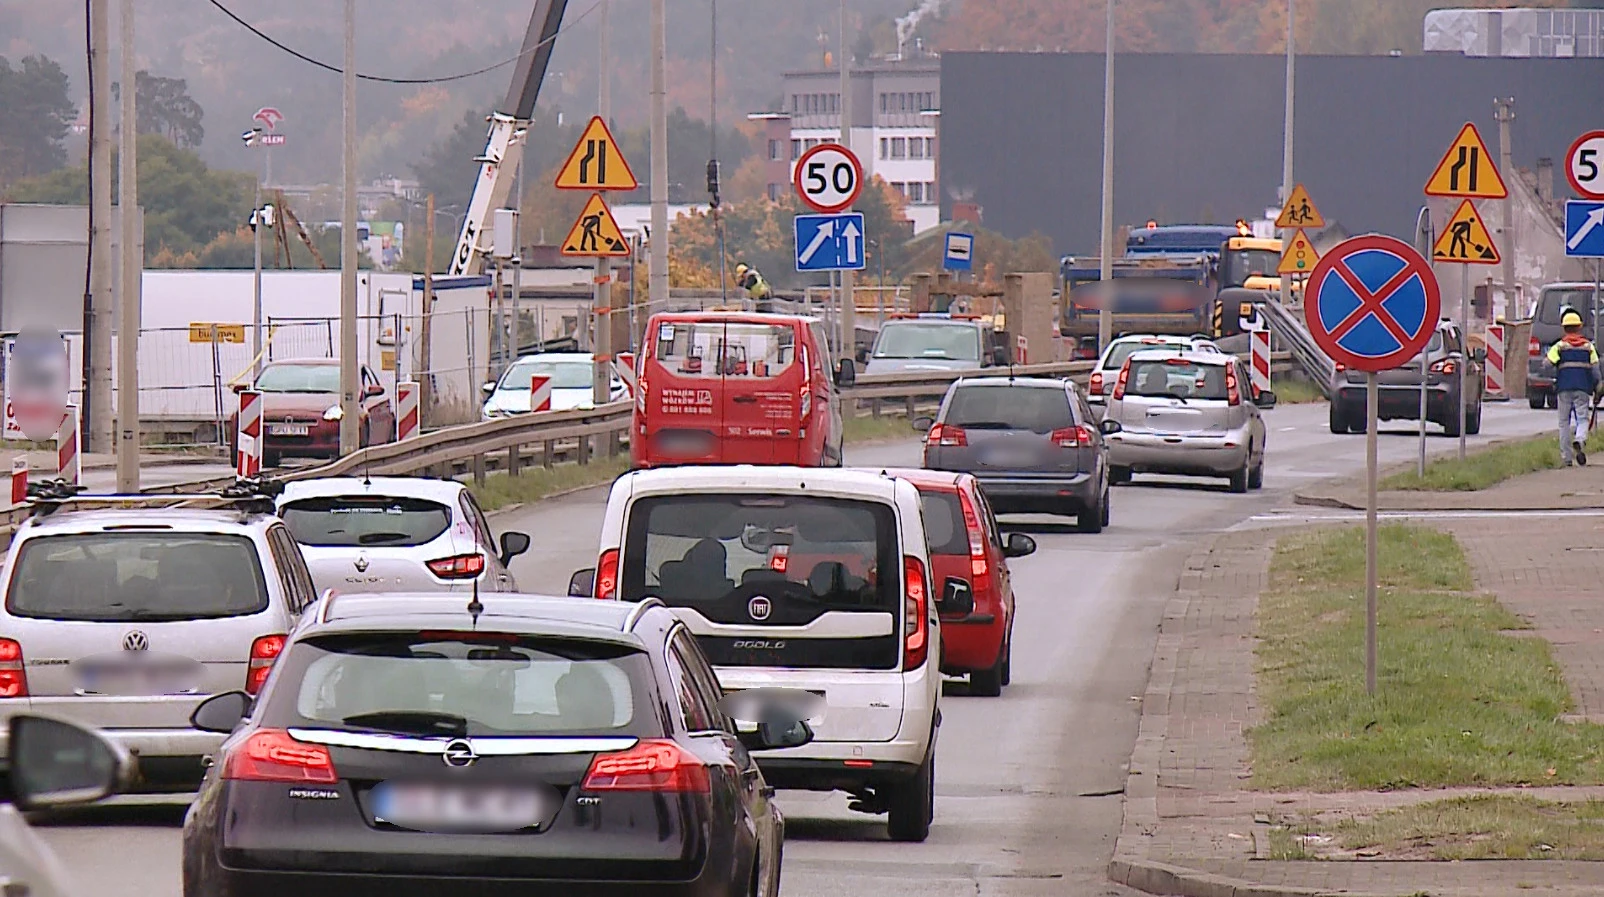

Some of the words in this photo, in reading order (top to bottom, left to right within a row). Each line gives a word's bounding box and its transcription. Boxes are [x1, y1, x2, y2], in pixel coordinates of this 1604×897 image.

[807, 162, 854, 195] 50
[1577, 149, 1604, 182] 5
[289, 790, 340, 799] INSIGNIA
